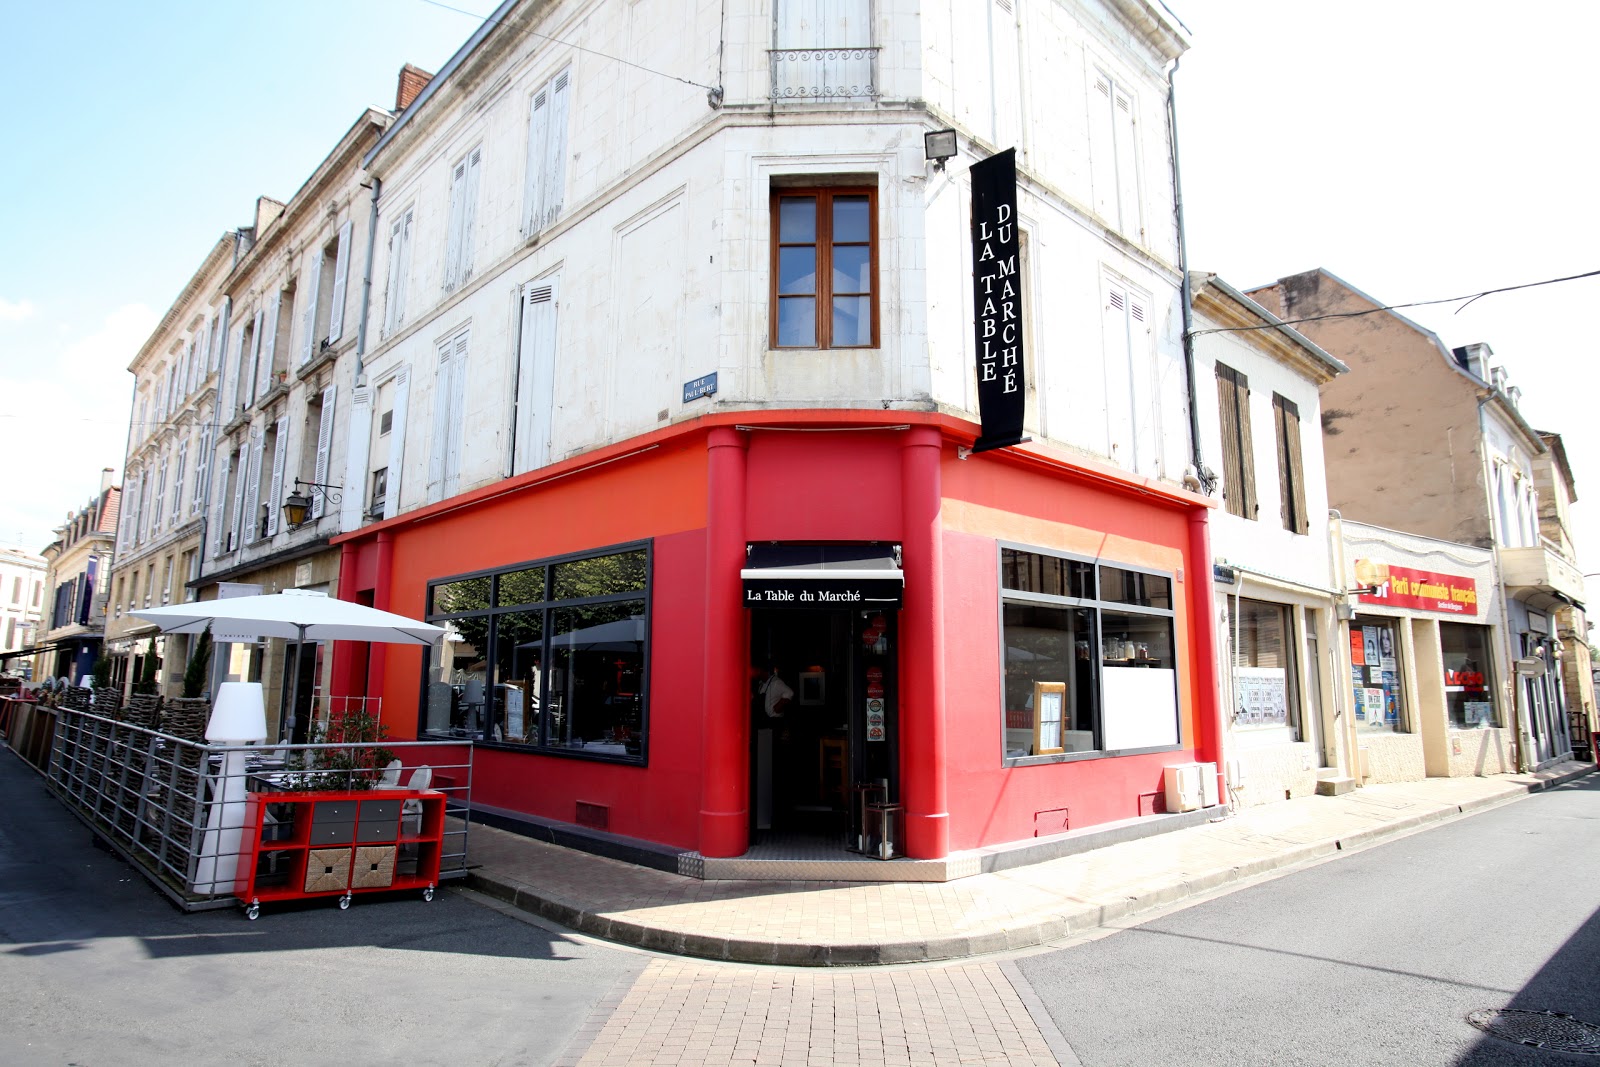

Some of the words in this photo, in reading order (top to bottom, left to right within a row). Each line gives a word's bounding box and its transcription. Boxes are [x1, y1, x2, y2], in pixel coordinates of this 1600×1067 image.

[979, 220, 996, 262] LA
[997, 203, 1012, 245] DU
[980, 274, 998, 382] TABLE
[997, 255, 1018, 394] MARCHÉ
[693, 379, 705, 388] RUE
[747, 589, 762, 601] La
[764, 589, 795, 601] Table
[800, 590, 815, 602] du
[817, 589, 861, 602] Marché
[1390, 575, 1409, 596] Parti
[1451, 585, 1476, 606] français
